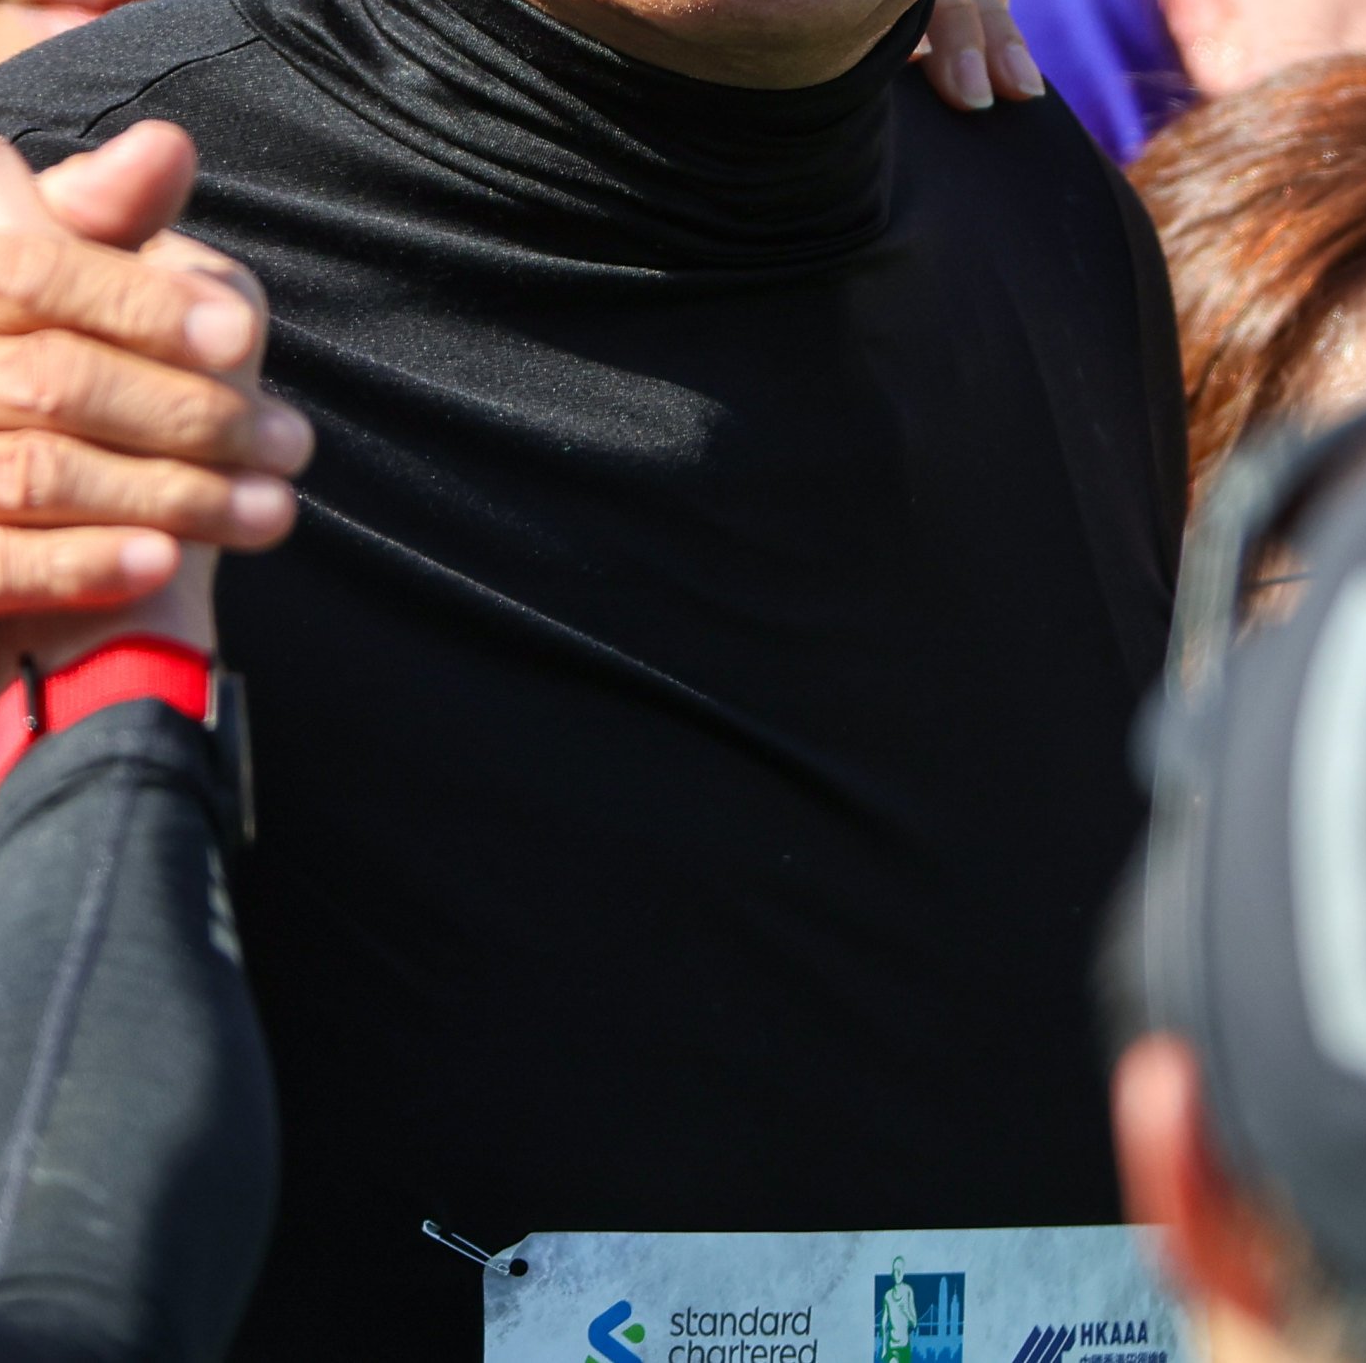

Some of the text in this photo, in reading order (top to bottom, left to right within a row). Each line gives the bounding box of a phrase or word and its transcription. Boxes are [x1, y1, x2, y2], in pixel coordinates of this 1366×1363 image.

[670, 1306, 812, 1336] standard
[1080, 1321, 1148, 1346] HKAAA
[668, 1339, 818, 1363] chartered
